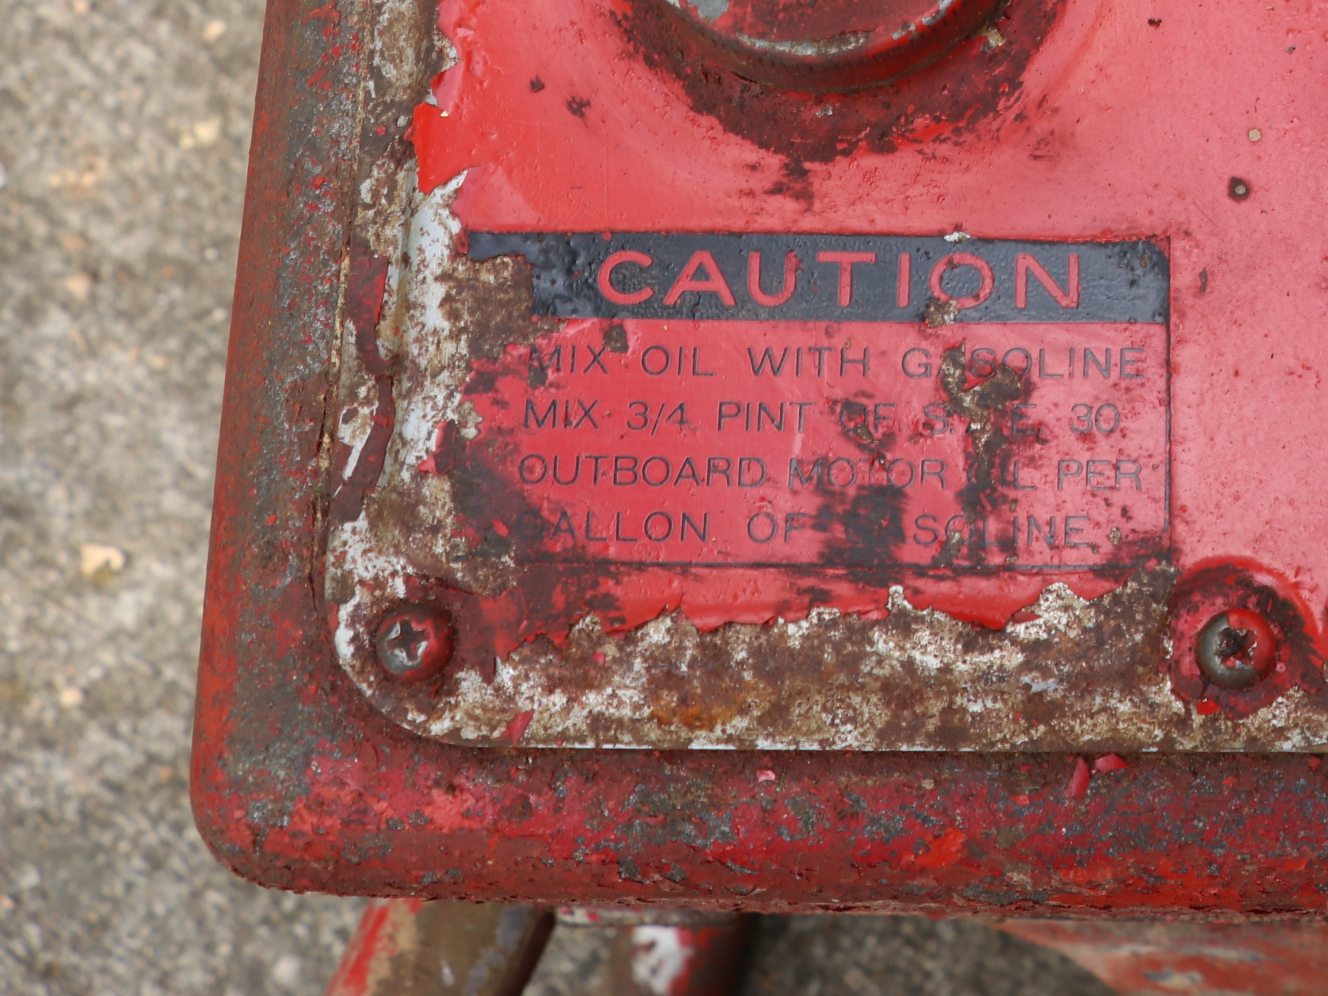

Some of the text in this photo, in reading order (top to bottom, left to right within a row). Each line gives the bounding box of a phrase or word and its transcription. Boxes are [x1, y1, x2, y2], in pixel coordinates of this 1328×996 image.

[597, 250, 1081, 308] CAUTION
[528, 344, 1146, 379] MIX OIL WITH GSOLINE
[523, 398, 601, 430] MIX
[626, 400, 691, 436] 3/4
[717, 401, 814, 433] PINT
[839, 402, 897, 434] OF
[1069, 403, 1121, 435] 30
[518, 454, 767, 488] OUTBOARD
[787, 457, 947, 491] MOTOR
[1056, 459, 1142, 492] PER
[746, 511, 809, 544] OF
